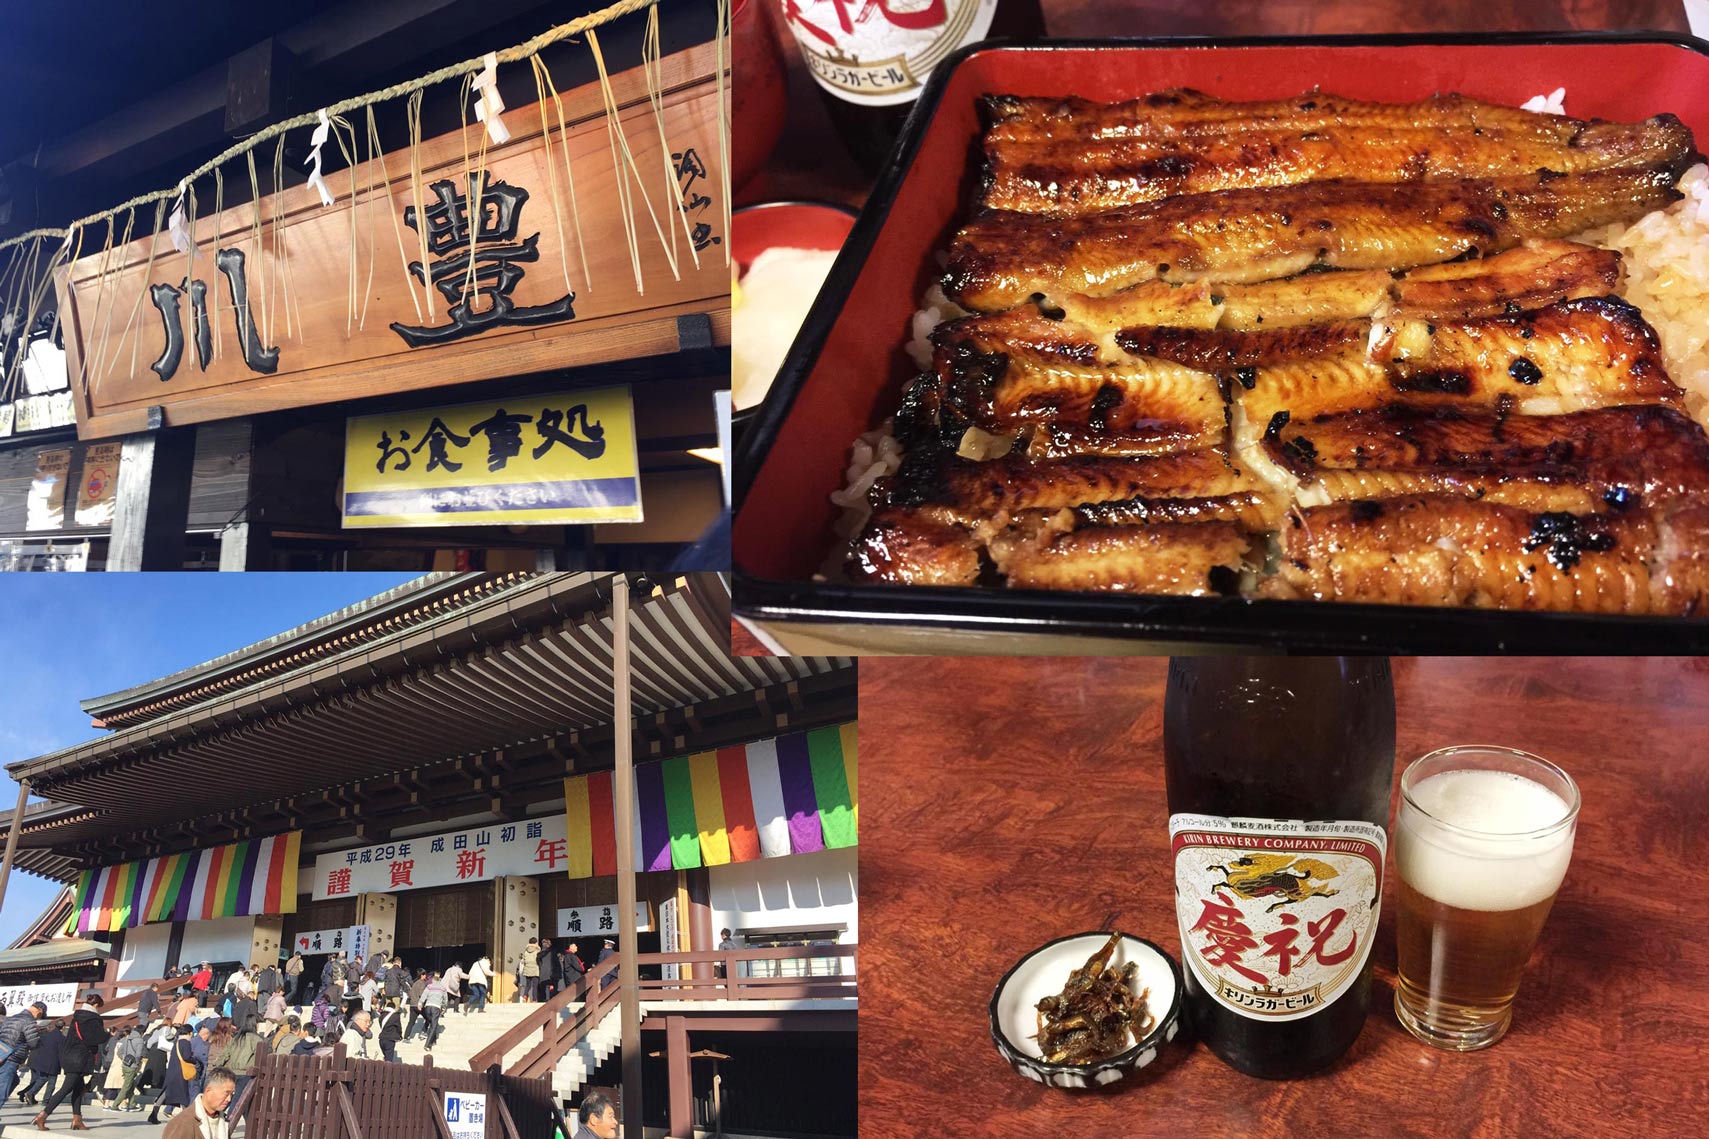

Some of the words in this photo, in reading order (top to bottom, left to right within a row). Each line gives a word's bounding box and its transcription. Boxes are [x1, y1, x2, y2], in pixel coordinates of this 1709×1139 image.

[376, 404, 606, 474] お食事処
[346, 843, 411, 866] 平成29年
[430, 821, 543, 853] 成田山初詣
[1183, 833, 1204, 844] KIRIN
[1206, 834, 1260, 847] BREWERY
[1330, 840, 1366, 853] LIMITED
[327, 838, 569, 896] 謹賀新年
[567, 916, 614, 933] 順路
[1224, 987, 1315, 1010] キリンラガービール
